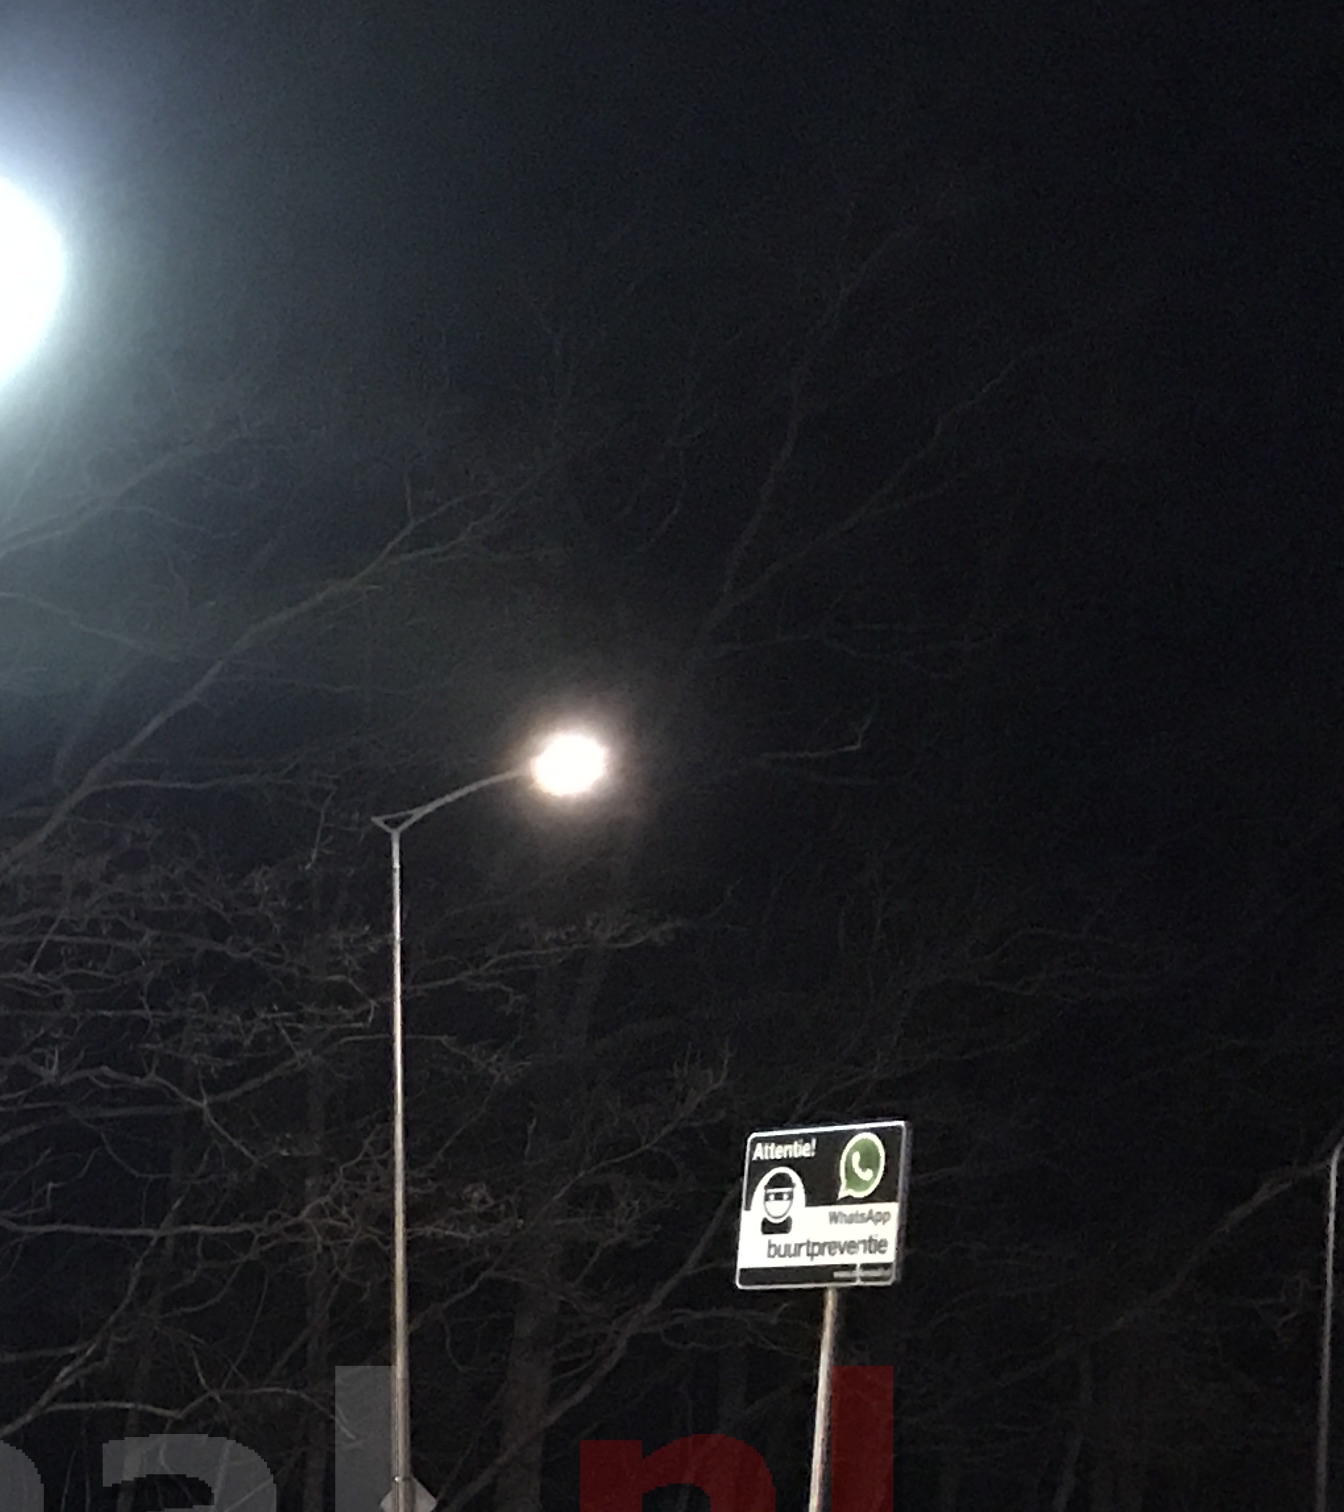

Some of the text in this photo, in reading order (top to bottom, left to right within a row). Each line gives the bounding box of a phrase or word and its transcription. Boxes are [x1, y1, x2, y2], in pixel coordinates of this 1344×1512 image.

[752, 1138, 816, 1160] Attentie!
[829, 1208, 891, 1225] WhatsApp
[767, 1236, 888, 1261] buurtpreventie
